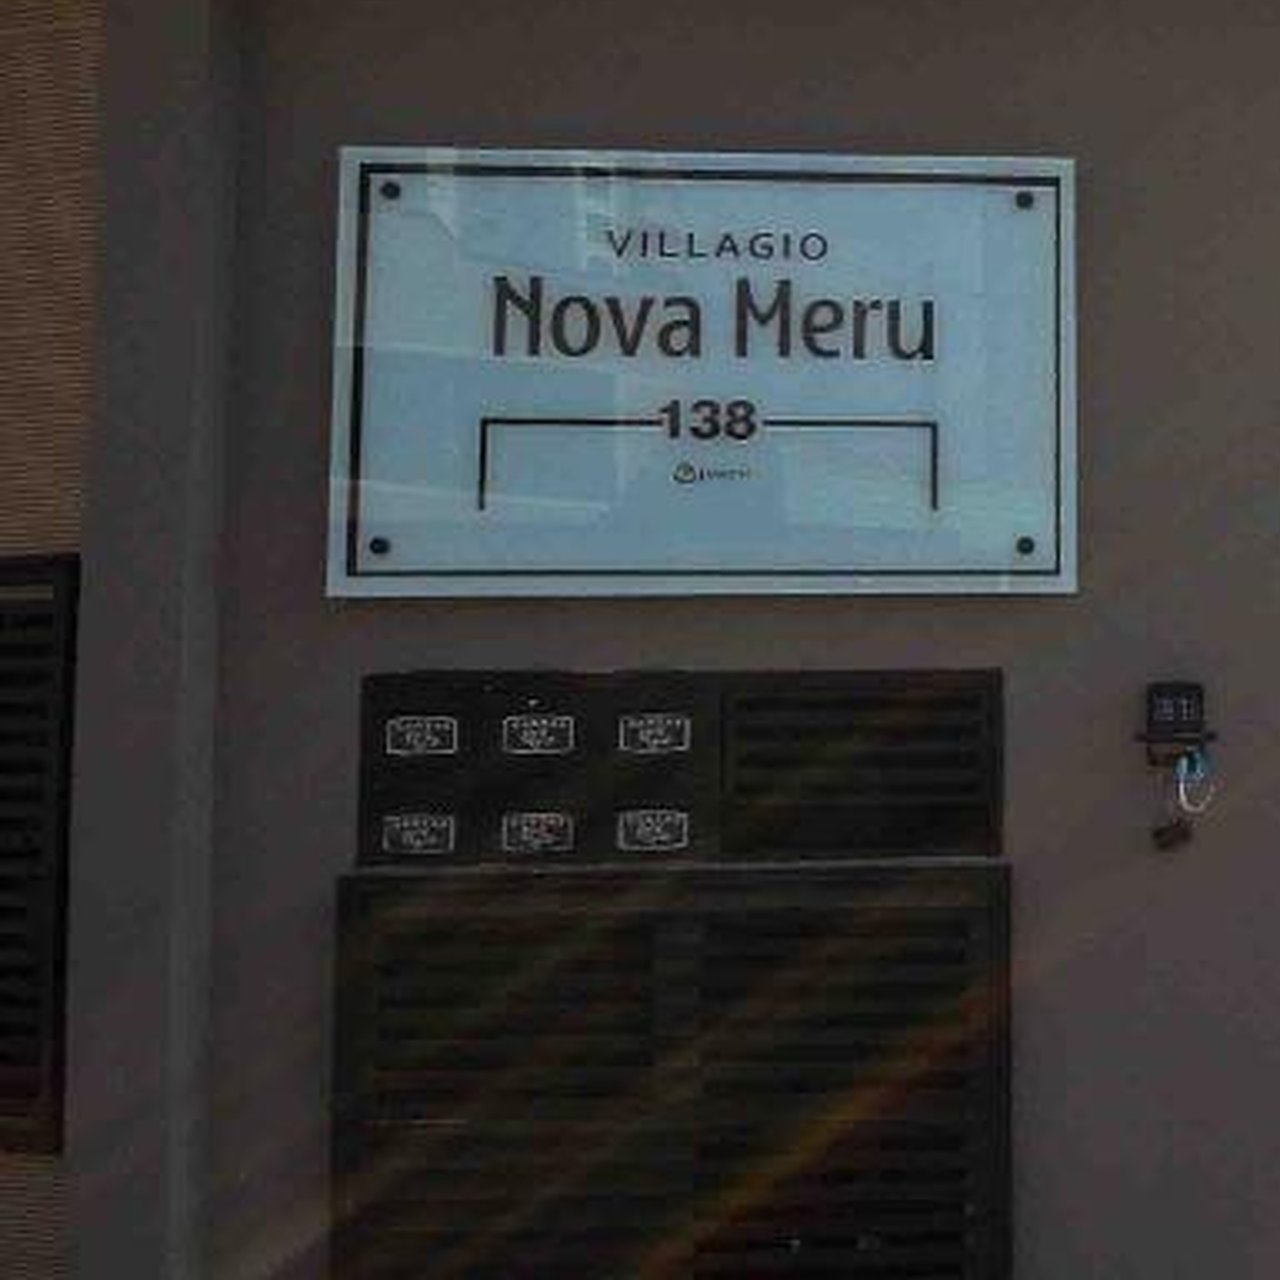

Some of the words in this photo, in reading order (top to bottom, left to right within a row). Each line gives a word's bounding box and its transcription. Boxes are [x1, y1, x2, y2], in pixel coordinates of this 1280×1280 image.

[603, 227, 830, 263] VILLAGIO
[490, 274, 704, 360] Nova
[734, 275, 938, 362] Meru
[658, 398, 759, 442] 138
